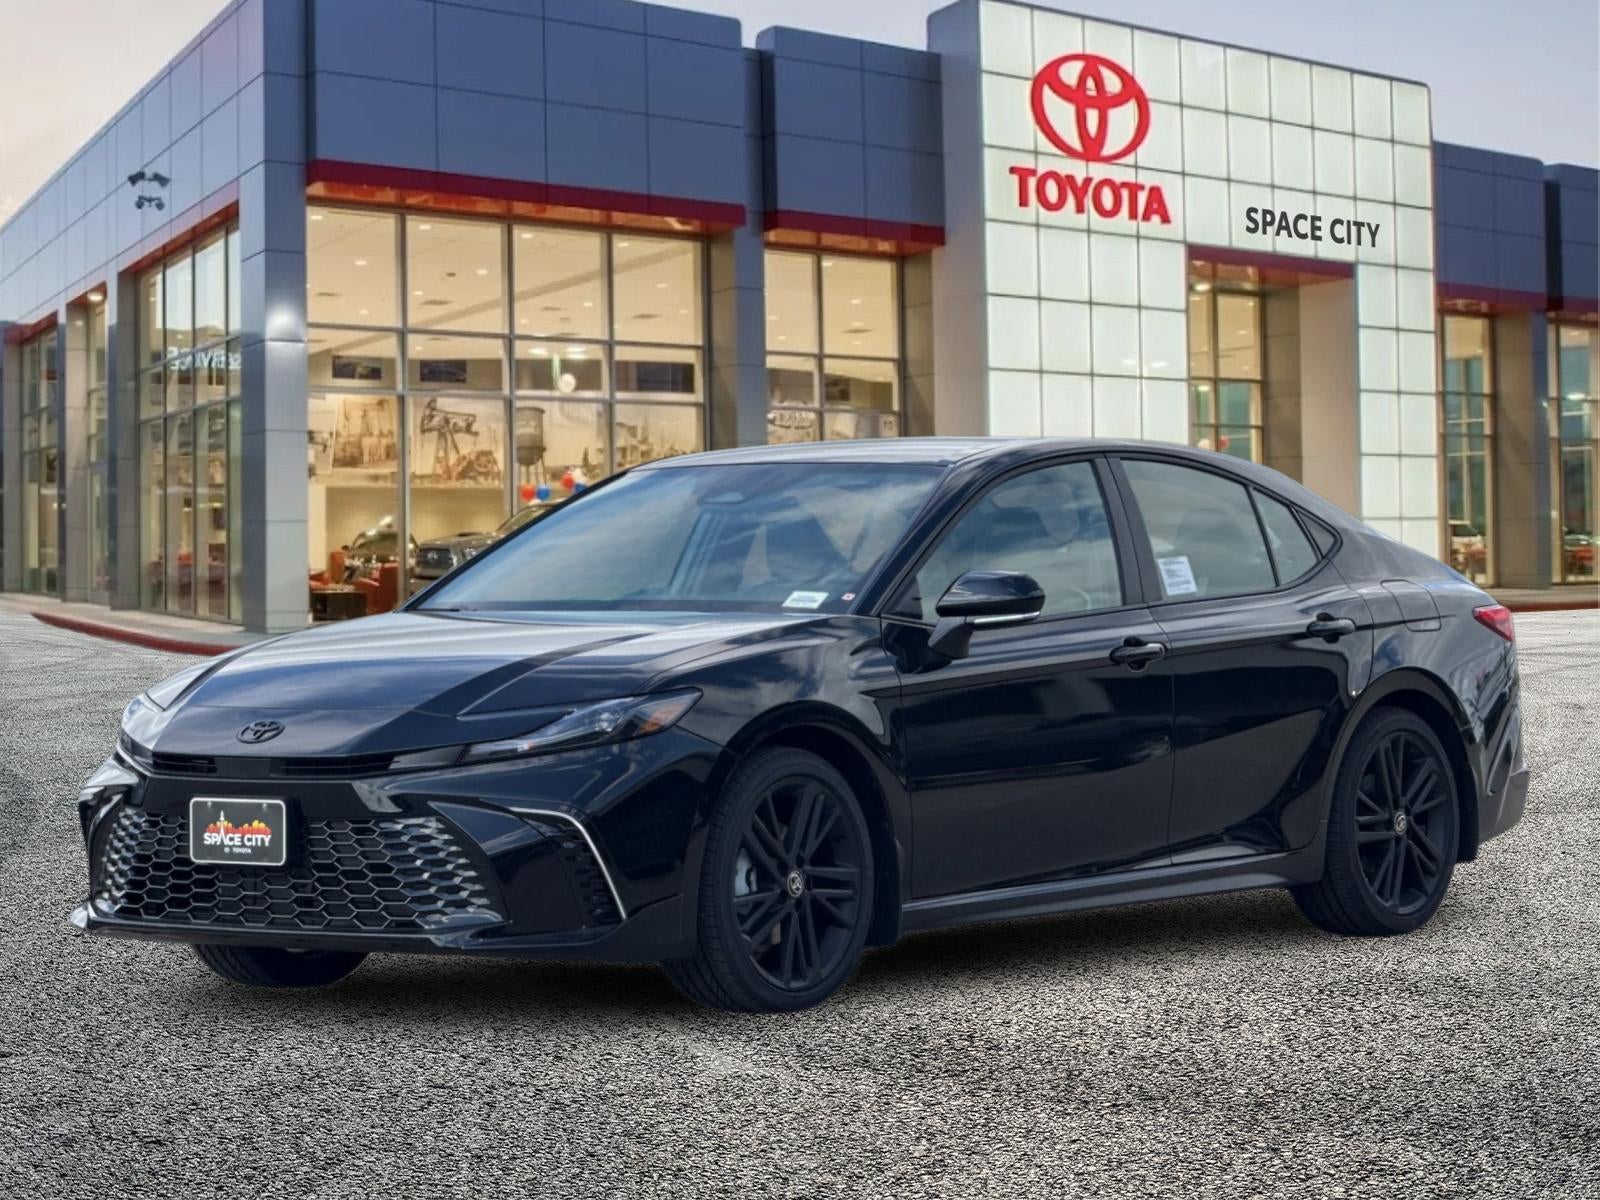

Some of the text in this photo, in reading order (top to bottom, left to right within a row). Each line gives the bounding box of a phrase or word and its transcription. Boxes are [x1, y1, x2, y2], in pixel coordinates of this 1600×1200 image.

[1009, 166, 1171, 224] TOYOTA
[1245, 206, 1380, 248] SPACE CITY
[203, 832, 272, 847] SPACE CITY
